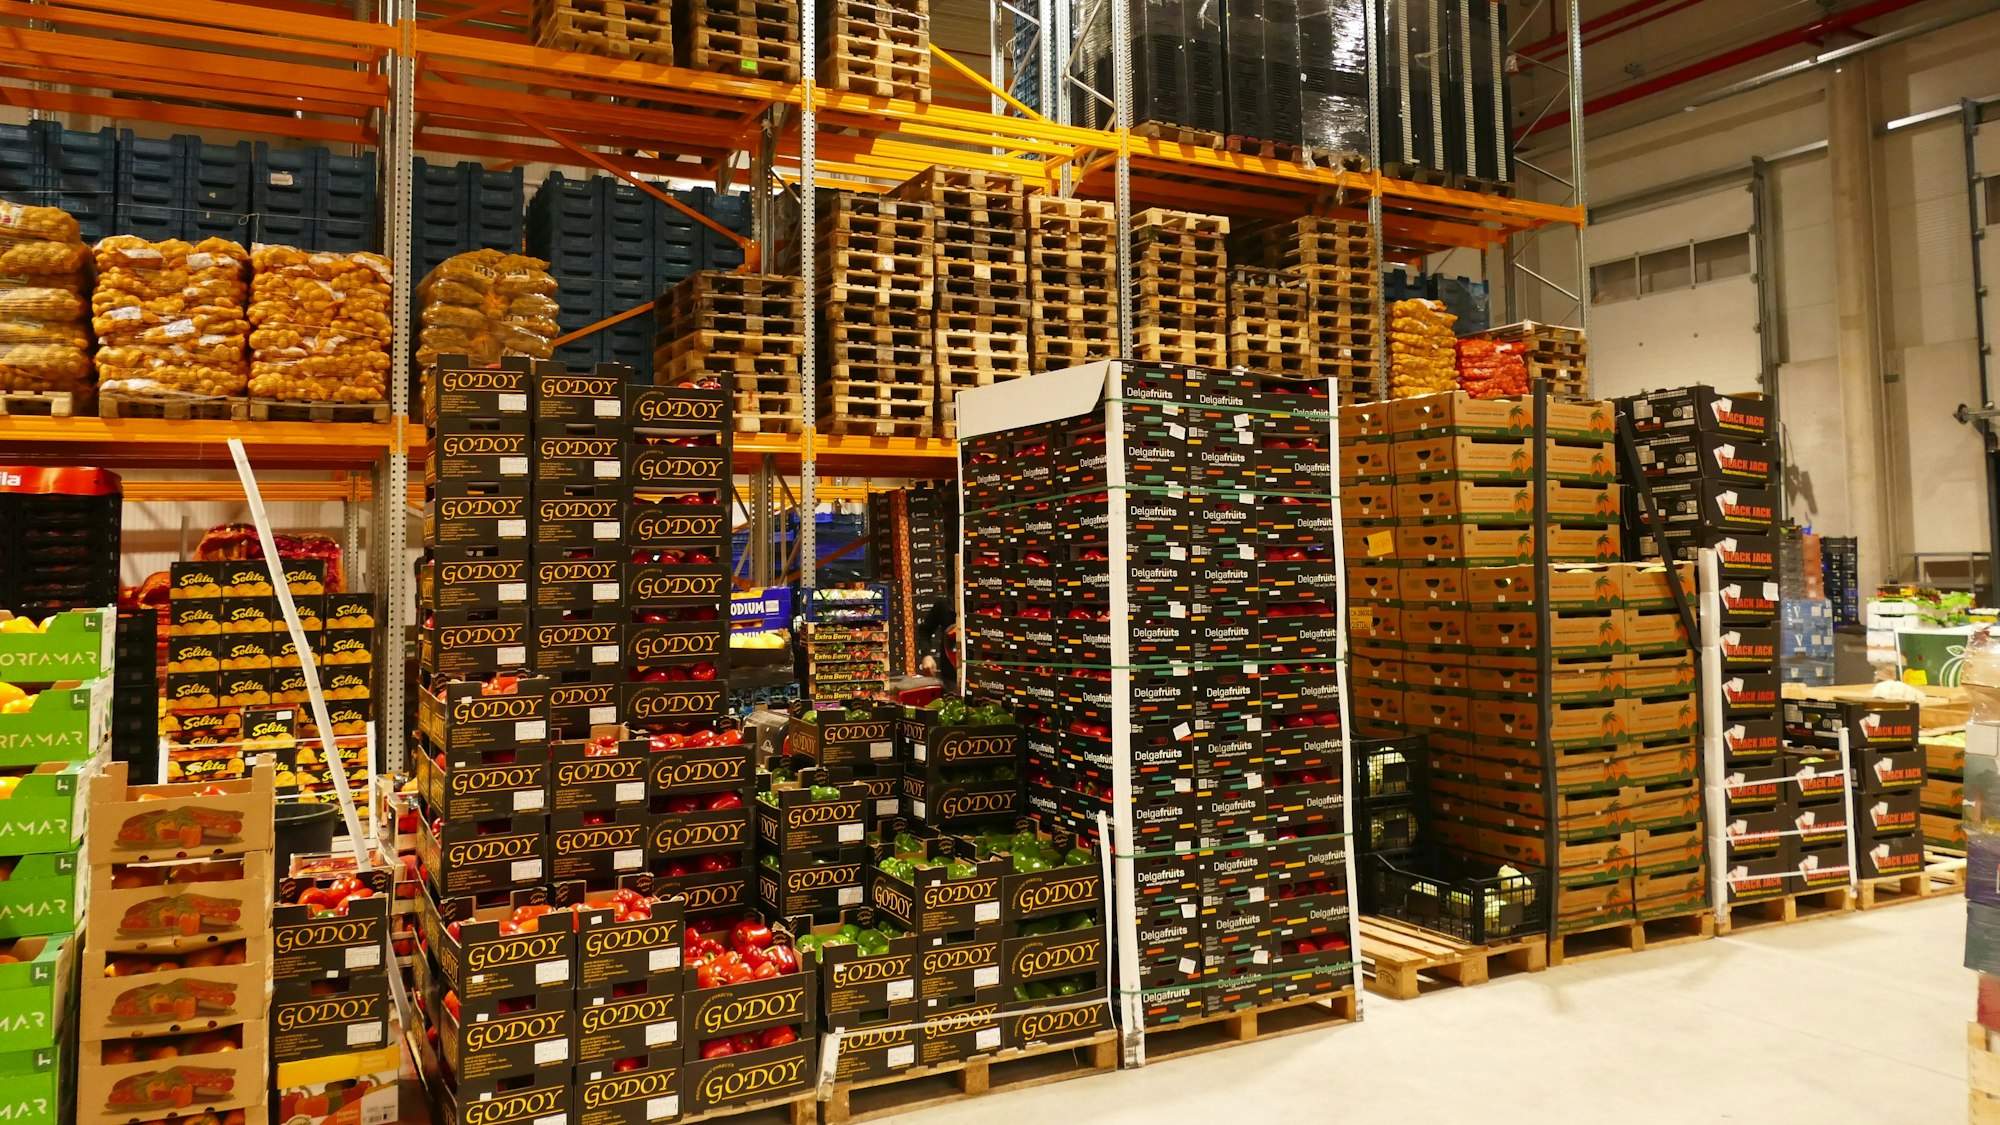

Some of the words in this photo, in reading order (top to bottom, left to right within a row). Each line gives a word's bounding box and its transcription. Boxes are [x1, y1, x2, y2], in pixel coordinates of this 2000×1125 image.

[442, 373, 522, 391] GODOY
[541, 379, 617, 398] GODOY
[639, 400, 723, 421] GODOY
[1719, 411, 1744, 425] BLACK
[1745, 414, 1765, 427] JACK
[444, 437, 525, 456] GODOY
[541, 440, 618, 459] GODOY
[639, 459, 723, 480] GODOY
[1722, 458, 1748, 470] BLACK
[1749, 460, 1768, 472] JACK
[441, 500, 523, 520] GODOY
[540, 502, 616, 521] GODOY
[1725, 504, 1750, 516] BLACK
[1751, 506, 1771, 518] JACK
[638, 518, 722, 539] GODOY
[1724, 551, 1750, 562] BLACK
[1752, 551, 1772, 563] JACK
[180, 573, 214, 587] Solita
[232, 571, 265, 584] Solita
[286, 570, 316, 582] Solita
[441, 564, 523, 585] GODOY
[539, 564, 616, 585] GODOY
[637, 577, 721, 600] GODOY
[336, 604, 368, 617] Solita
[1728, 597, 1752, 609] BLACK
[1753, 598, 1774, 609] JACK
[180, 609, 213, 623] Solita
[231, 607, 264, 620] Solita
[332, 639, 365, 652] Solita
[440, 627, 521, 649] GODOY
[538, 626, 616, 648] GODOY
[635, 635, 719, 659] GODOY
[814, 633, 832, 641] Extra
[833, 633, 851, 641] Berry
[178, 646, 212, 660] Solita
[231, 644, 264, 657] Solita
[833, 653, 851, 661] Berry
[1727, 644, 1753, 656] BLACK
[1755, 644, 1774, 656] JACK
[230, 680, 263, 694] Solita
[331, 675, 363, 688] Solita
[834, 673, 852, 681] Berry
[176, 683, 210, 697] Solita
[550, 687, 613, 706] ODOY
[1731, 691, 1755, 702] BLACK
[1757, 690, 1775, 702] JACK
[331, 710, 362, 723] Solita
[454, 699, 542, 724] GODOY
[634, 694, 720, 719] GODOY
[183, 714, 223, 730] Solita
[252, 722, 288, 737] Solita
[1867, 726, 1892, 738] BLACK
[1894, 725, 1912, 737] JACK
[824, 724, 889, 744] GODOY
[1733, 738, 1757, 750] BLACK
[1758, 737, 1777, 749] JACK
[943, 737, 1017, 761] GODOY
[185, 760, 226, 776] Solita
[558, 760, 641, 785] GODOY
[657, 760, 745, 788] GODOY
[1881, 769, 1903, 781] BLACK
[1904, 767, 1921, 779] JACK
[452, 768, 540, 795] GODOY
[1731, 785, 1756, 797] BLACK
[1758, 784, 1777, 795] JACK
[943, 792, 1016, 818] GODOY
[788, 804, 860, 829] GODOY
[1877, 812, 1899, 825] BLACK
[1899, 811, 1915, 823] JACK
[760, 815, 778, 840] DOY
[556, 828, 639, 855] GODOY
[656, 824, 745, 852] GODOY
[450, 837, 538, 867] GODOY
[1878, 855, 1902, 868] BLACK
[1902, 854, 1919, 866] JACK
[788, 866, 860, 893] GODOY
[1736, 877, 1760, 890] BLACK
[1761, 876, 1782, 888] JACK
[875, 886, 912, 919] GODOY
[925, 881, 997, 909] GODOY
[1020, 879, 1099, 914] GODOY
[276, 922, 376, 953] GODOY
[585, 923, 676, 956] GODOY
[468, 935, 564, 970] GODOY
[923, 945, 996, 975] GODOY
[1019, 943, 1099, 977] GODOY
[833, 958, 910, 988] GODOY
[277, 998, 377, 1030] GODOY
[582, 999, 673, 1033] GODOY
[705, 992, 802, 1032] GODOY
[466, 1010, 564, 1051] GODOY
[1022, 1005, 1102, 1040] GODOY
[584, 1072, 675, 1108] GODOY
[706, 1060, 804, 1103] GODOY
[466, 1089, 563, 1125] GODOY
